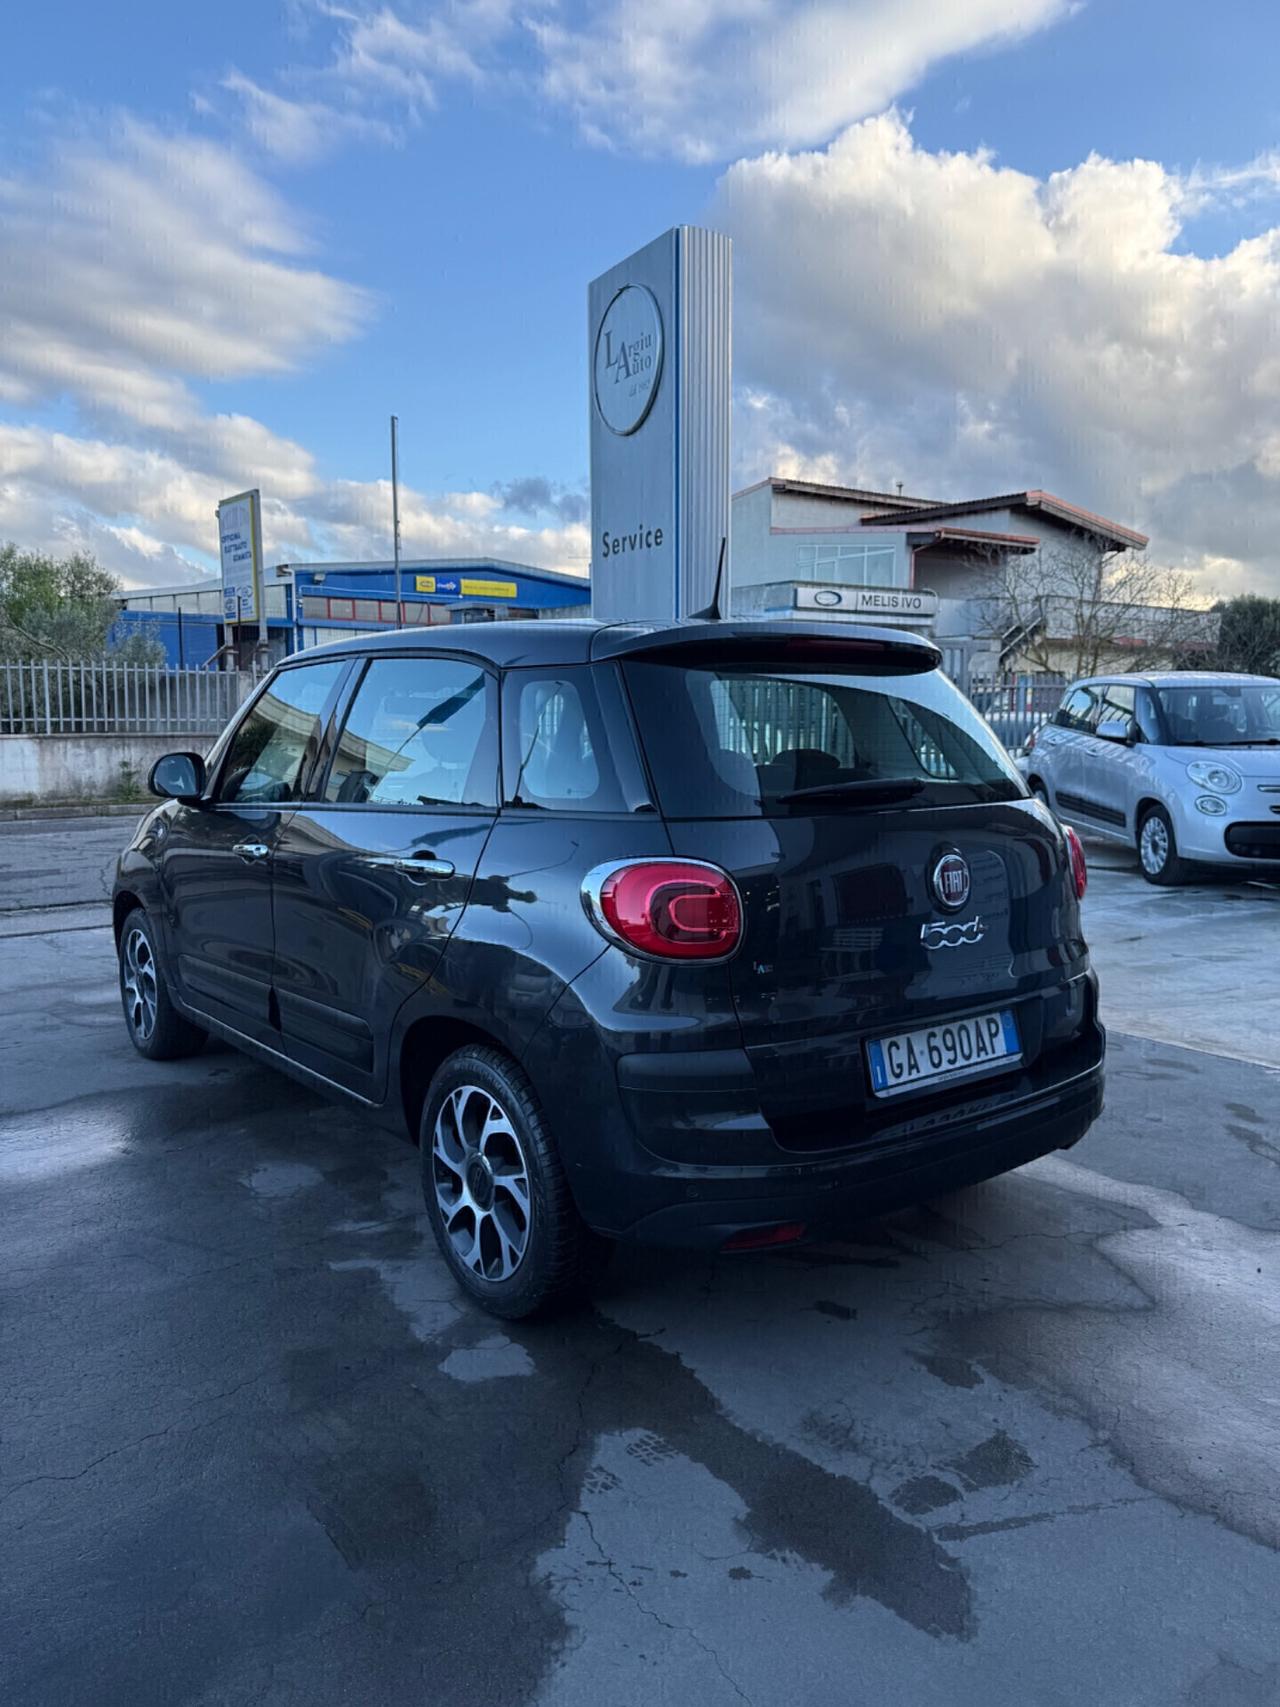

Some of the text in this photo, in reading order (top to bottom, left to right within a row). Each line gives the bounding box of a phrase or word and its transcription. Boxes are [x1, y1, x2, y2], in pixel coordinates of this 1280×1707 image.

[602, 523, 664, 558] Service
[861, 594, 922, 609] MELIS IVO
[943, 870, 963, 894] FIAT
